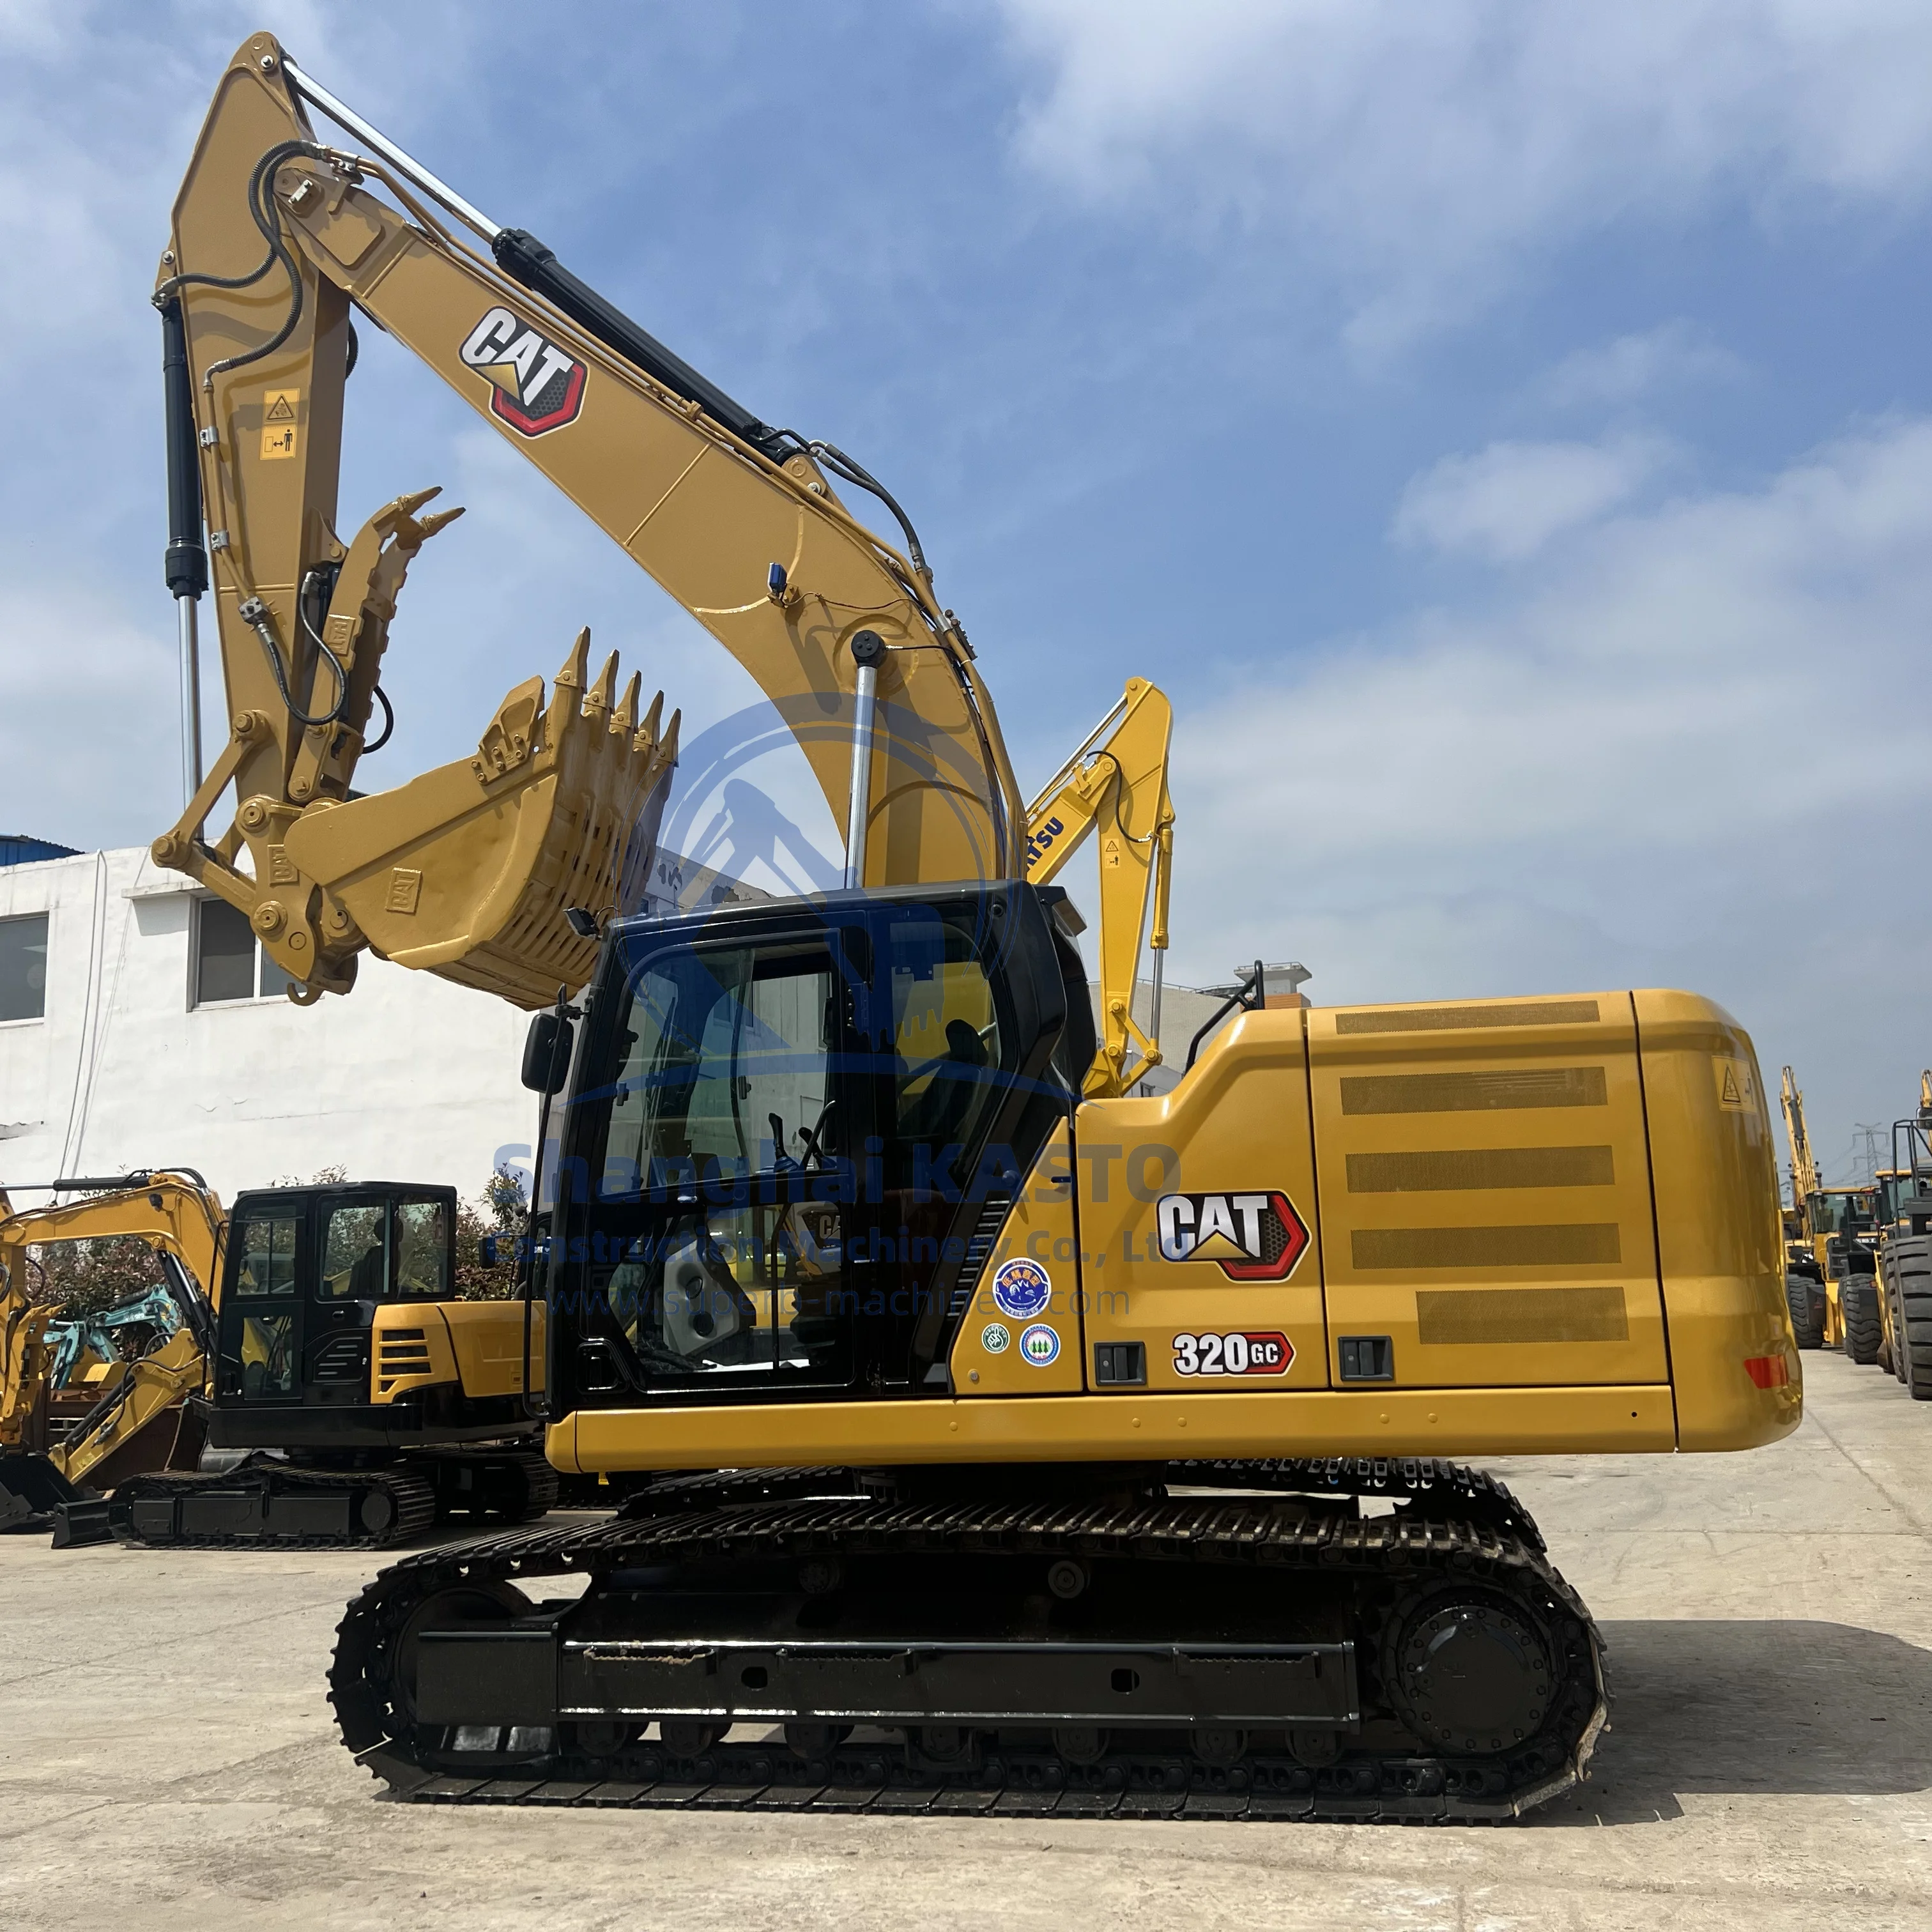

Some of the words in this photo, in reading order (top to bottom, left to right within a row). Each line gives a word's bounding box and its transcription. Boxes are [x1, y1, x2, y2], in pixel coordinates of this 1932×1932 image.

[461, 307, 574, 406] CAT
[329, 619, 348, 652] CAT
[271, 848, 293, 882] CAT
[391, 872, 416, 908] CAT
[1158, 1195, 1268, 1261] CAT
[1174, 1333, 1248, 1374] 320
[1251, 1343, 1278, 1364] GC
